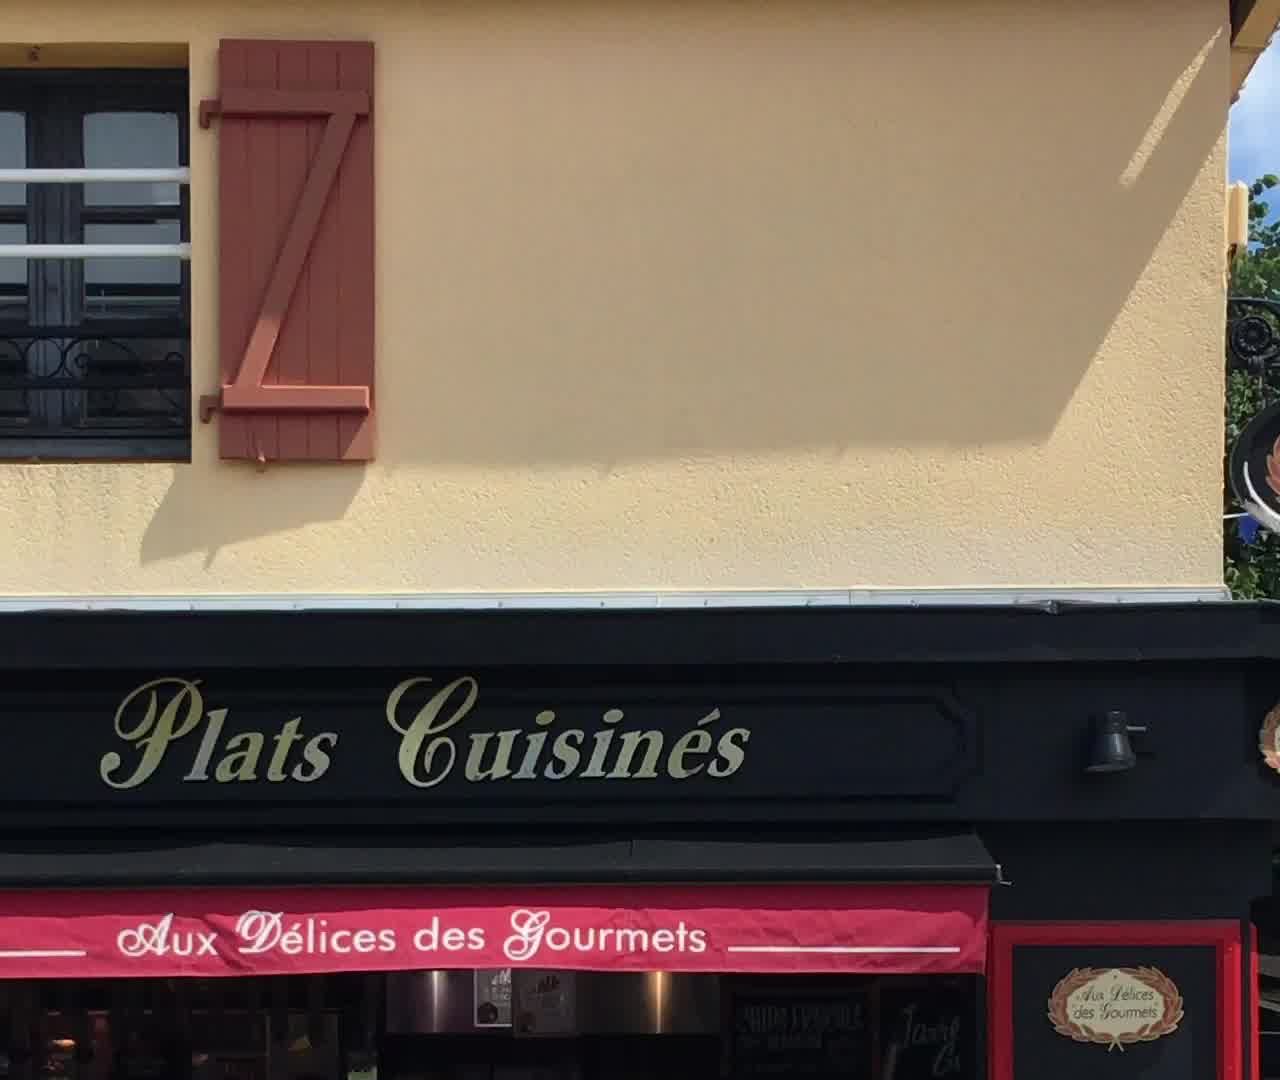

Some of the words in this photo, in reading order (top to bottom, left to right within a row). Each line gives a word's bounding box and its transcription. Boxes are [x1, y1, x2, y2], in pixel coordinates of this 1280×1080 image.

[99, 677, 339, 790] Plats
[384, 675, 752, 789] Cuisinés
[116, 911, 219, 957] Aux
[234, 909, 397, 955] Délices
[413, 917, 486, 953] des
[502, 909, 708, 961] Gourmets
[1076, 985, 1105, 1002] Aux
[1073, 1004, 1095, 1020] des
[1101, 1002, 1159, 1021] Gourmets
